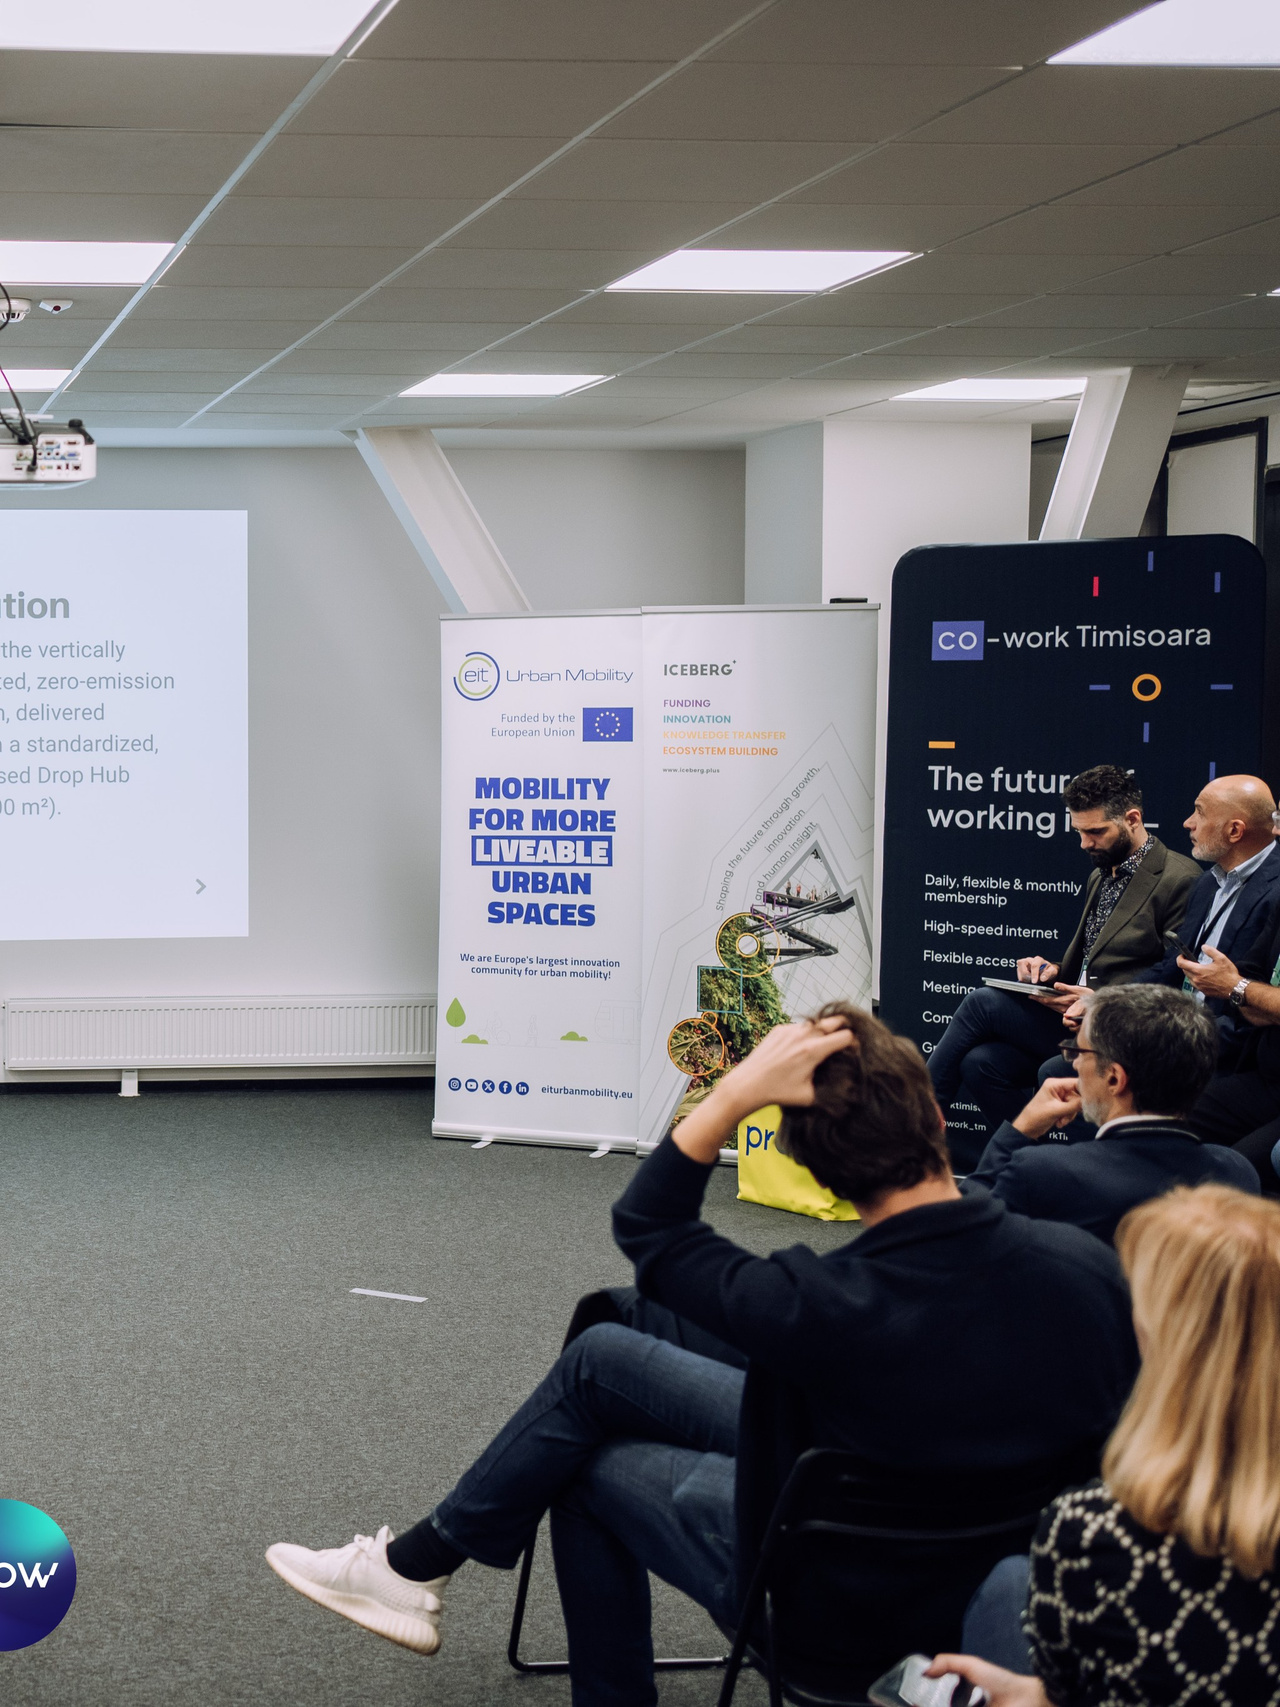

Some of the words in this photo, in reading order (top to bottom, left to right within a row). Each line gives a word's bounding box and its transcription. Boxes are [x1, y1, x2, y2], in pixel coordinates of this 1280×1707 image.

[1076, 624, 1211, 648] Timisoara
[0, 640, 32, 658] the
[38, 640, 126, 662] vertically
[37, 672, 175, 690] zero-emission
[506, 670, 562, 682] Urban
[566, 668, 634, 684] Mobility
[16, 702, 105, 721] delivered
[663, 699, 711, 708] FUNDING
[501, 713, 539, 723] Funded
[542, 713, 555, 724] by
[558, 712, 576, 723] the
[663, 715, 732, 724] INNOVATION
[491, 728, 540, 739] European
[544, 727, 576, 737] Union
[663, 731, 730, 740] KNOWLEDGE
[732, 731, 786, 740] TRANSFER
[10, 739, 20, 752] a
[26, 734, 159, 755] standardized,
[663, 746, 726, 755] ECOSYSTEM
[729, 747, 778, 756] BUILDING
[38, 766, 84, 788] Drop
[90, 765, 130, 784] Hub
[928, 766, 984, 792] The
[990, 766, 1078, 794] futur
[475, 776, 611, 801] MOBILITY
[468, 808, 524, 831] FOR
[532, 809, 616, 833] MORE
[765, 808, 806, 853] innovation
[927, 804, 1056, 838] working
[728, 854, 742, 868] the
[740, 829, 764, 856] future
[762, 796, 793, 830] through
[474, 838, 608, 864] LIVEABLE
[492, 870, 592, 895] URBAN
[754, 880, 765, 901] and
[762, 849, 792, 881] human
[925, 874, 960, 890] Daily,
[962, 876, 1010, 890] flexible
[1013, 878, 1024, 891] &
[1026, 880, 1082, 896] monthly
[924, 892, 1008, 908] membership
[487, 901, 596, 927] SPACES
[924, 920, 1003, 936] High-speed
[1006, 924, 1058, 940] internet
[460, 953, 475, 962] We
[494, 954, 534, 966] Europe's
[536, 956, 568, 967] largest
[571, 957, 620, 968] innovation
[923, 950, 973, 965] Flexible
[976, 956, 1018, 968] acces
[471, 966, 522, 978] community
[524, 967, 538, 976] for
[540, 968, 567, 977] urban
[570, 970, 611, 981] mobility!
[542, 1084, 633, 1100] eiturbanmobility.eu
[746, 1125, 775, 1156] pr
